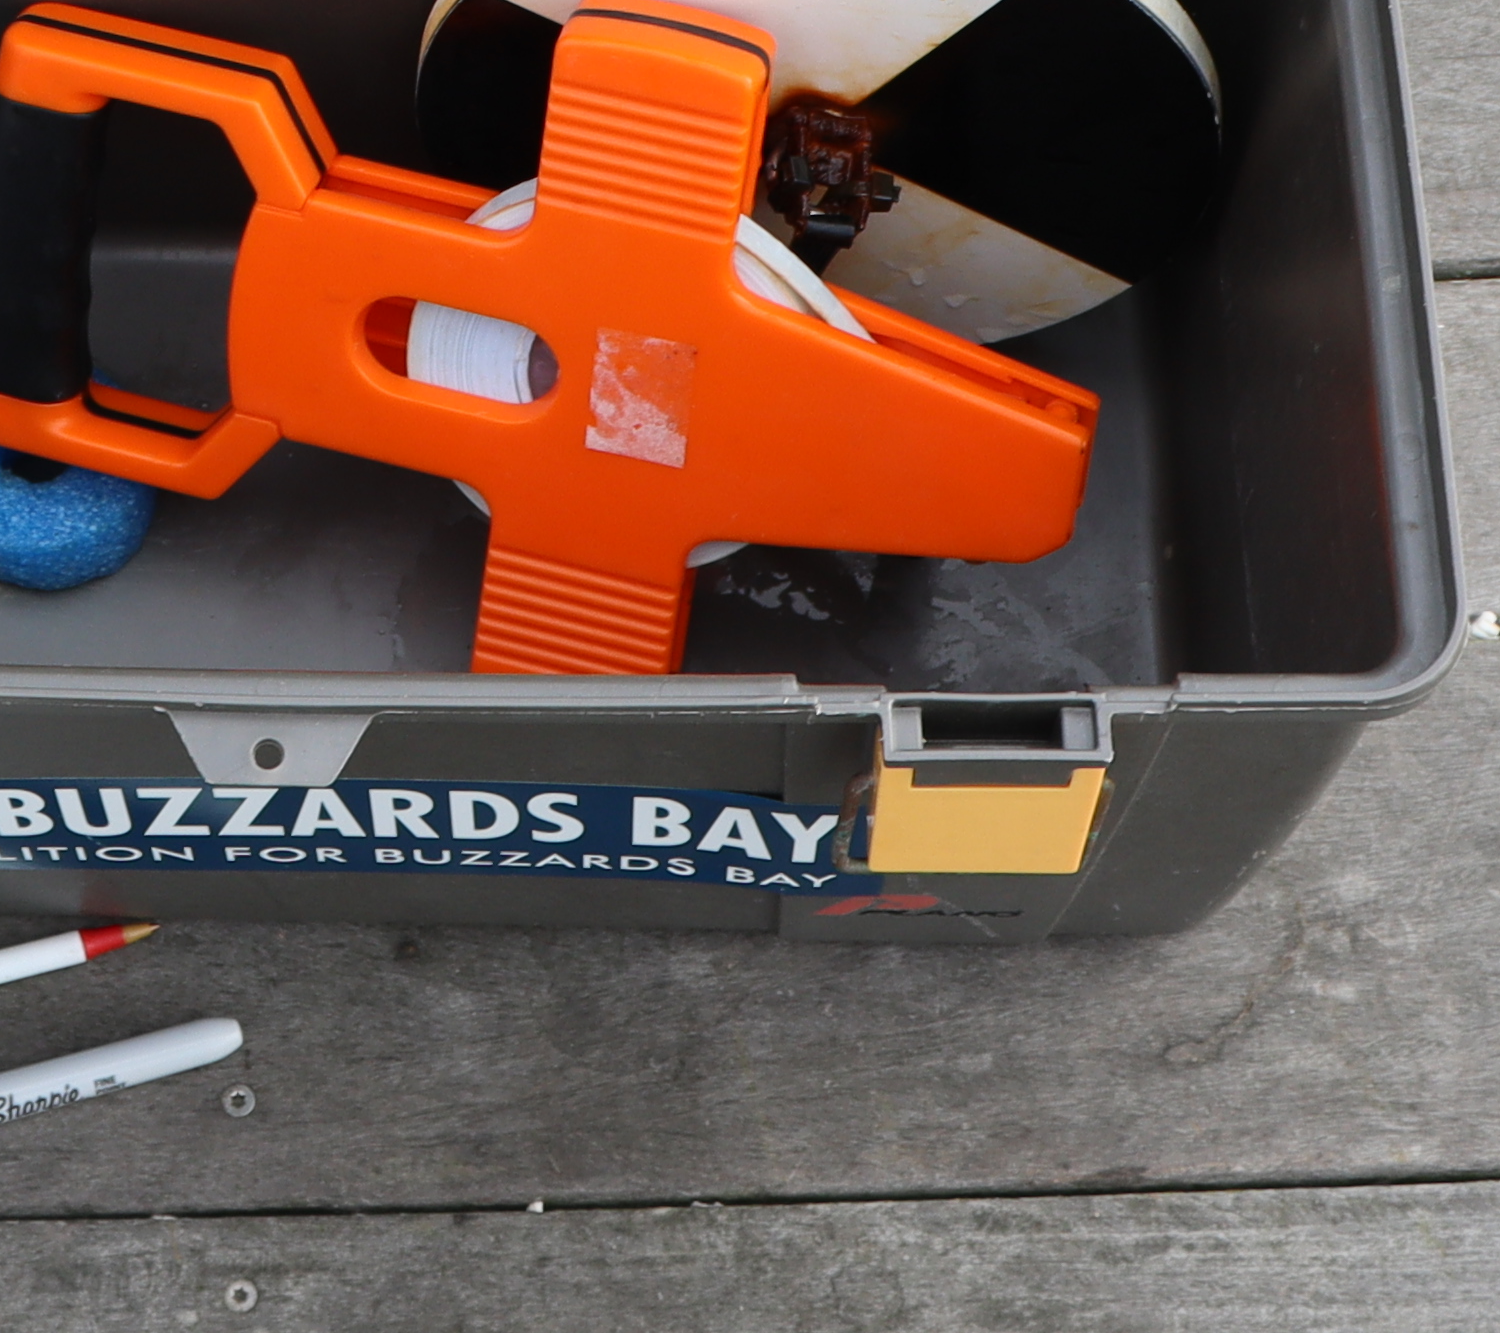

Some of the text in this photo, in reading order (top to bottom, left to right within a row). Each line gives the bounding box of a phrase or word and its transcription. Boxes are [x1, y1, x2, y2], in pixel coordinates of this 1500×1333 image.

[631, 795, 841, 864] BAY
[225, 845, 348, 865] FOR
[375, 846, 695, 878] BUZZARDS
[724, 866, 838, 889] BAY
